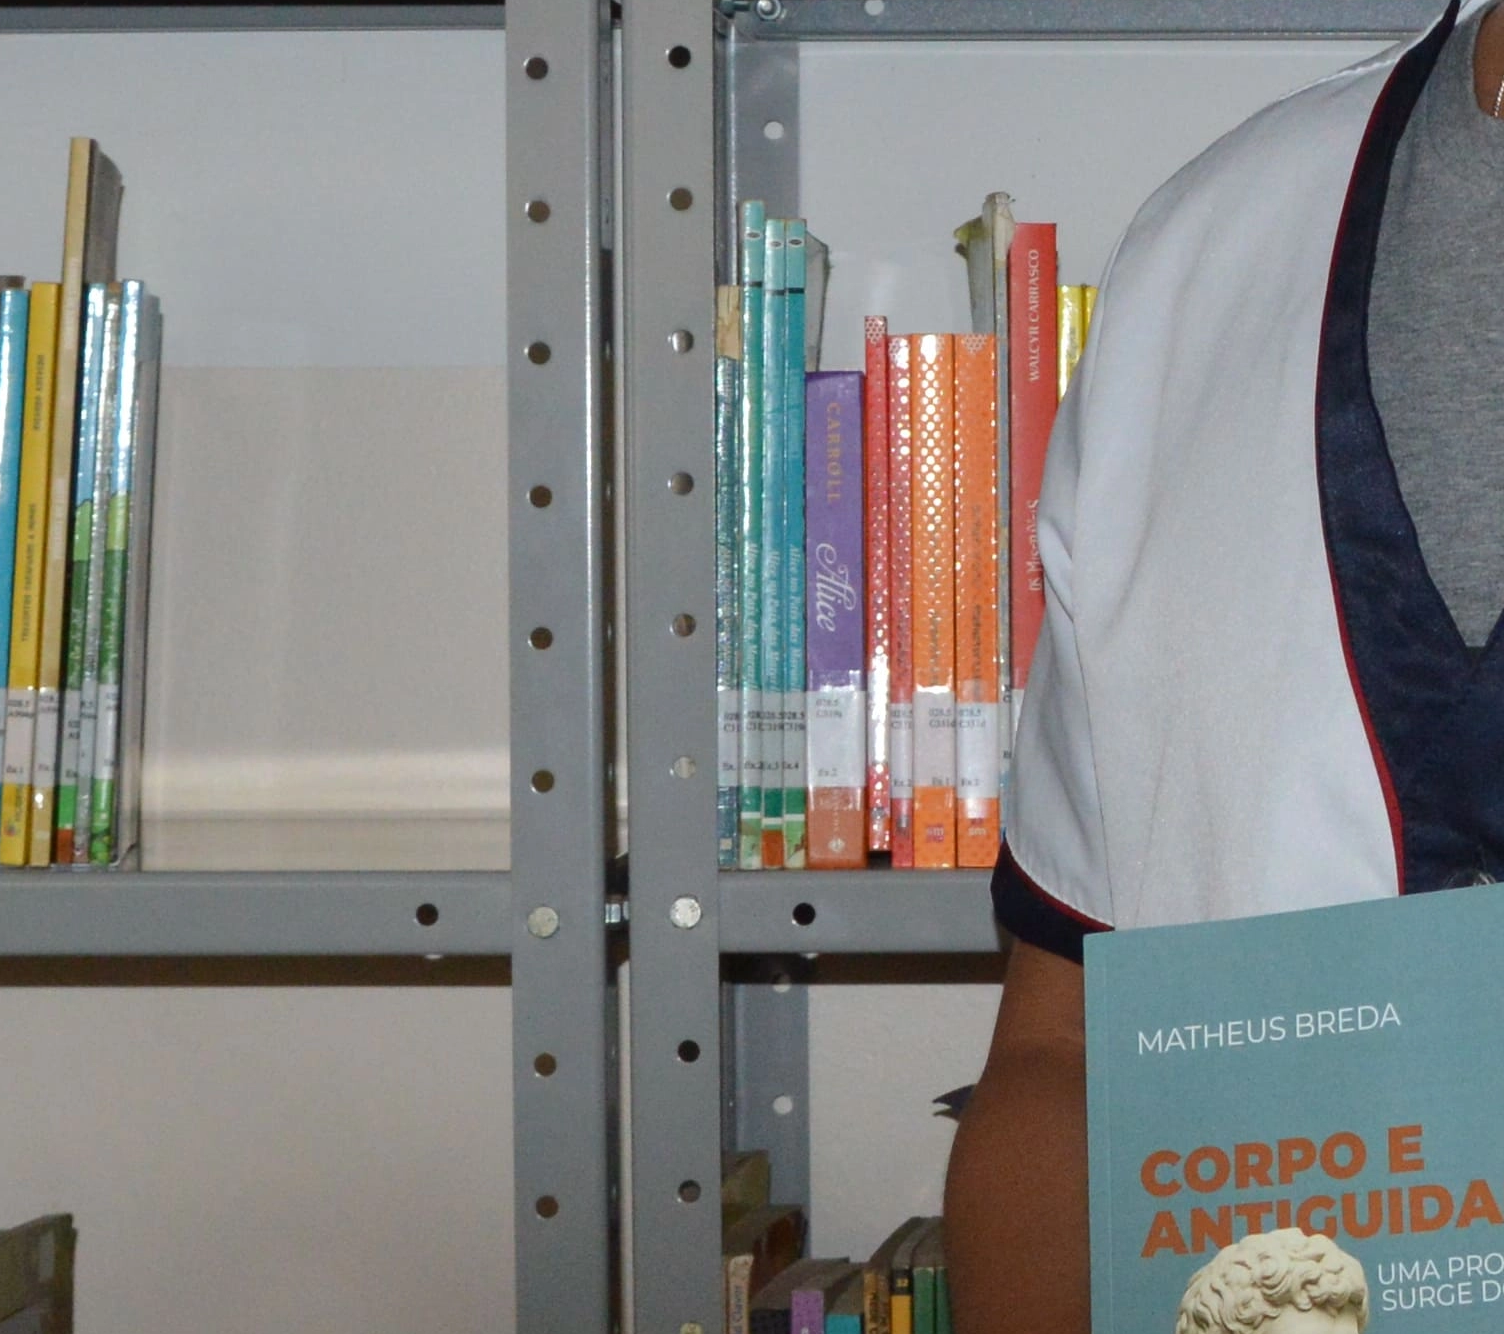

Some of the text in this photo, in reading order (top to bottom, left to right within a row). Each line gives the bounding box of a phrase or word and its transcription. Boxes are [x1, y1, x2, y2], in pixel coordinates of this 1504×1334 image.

[1027, 249, 1041, 381] WALCYR CARRASCO
[826, 402, 843, 504] CARROLL
[816, 543, 857, 632] Alice
[1137, 1003, 1402, 1055] MATHEUS BREDA
[1140, 1124, 1425, 1197] CORPO E
[1377, 1259, 1437, 1286] UMA
[1382, 1283, 1473, 1311] SURGE
